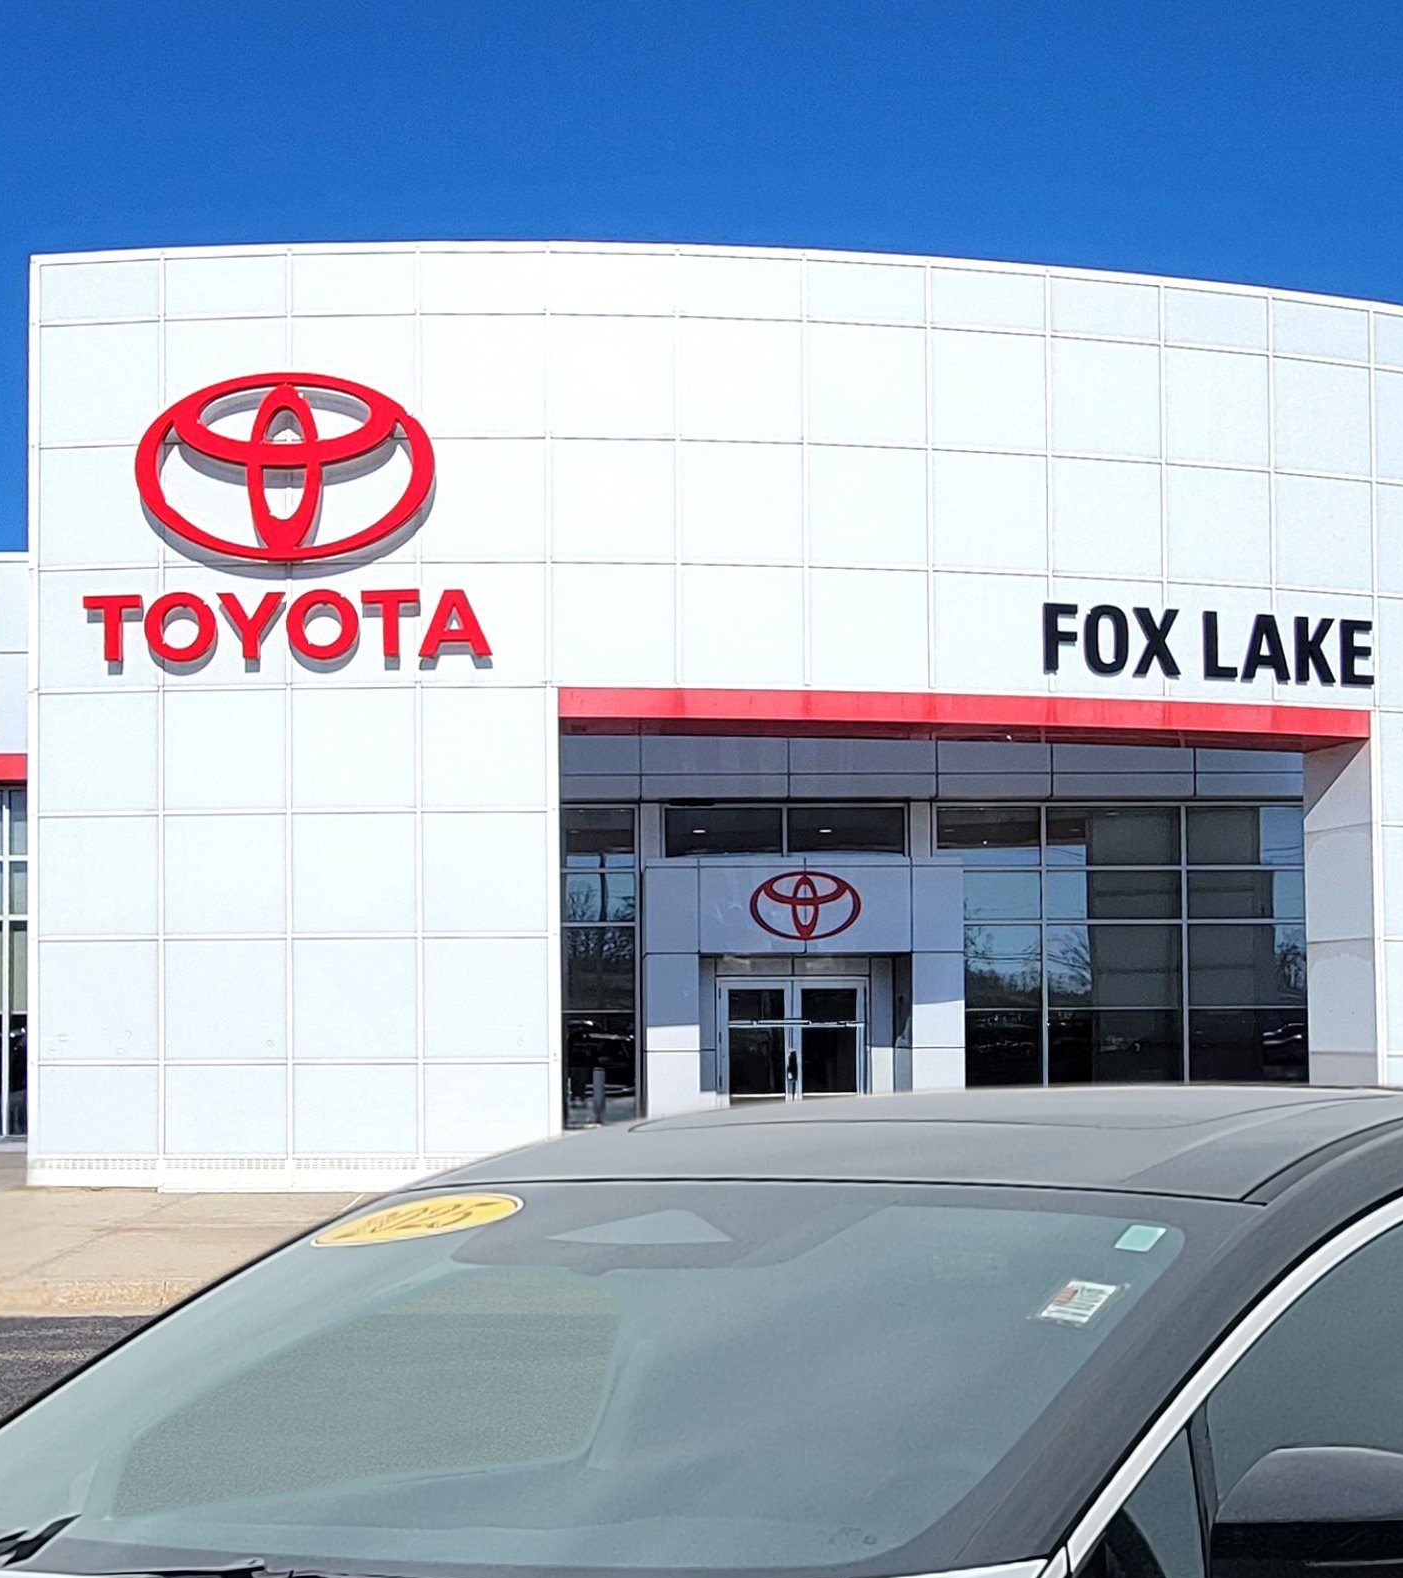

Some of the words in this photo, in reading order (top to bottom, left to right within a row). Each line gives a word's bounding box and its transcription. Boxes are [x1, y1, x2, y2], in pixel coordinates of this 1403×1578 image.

[83, 589, 493, 670] TOYOTA
[1043, 602, 1181, 679] FOX
[1202, 611, 1375, 686] LAKE
